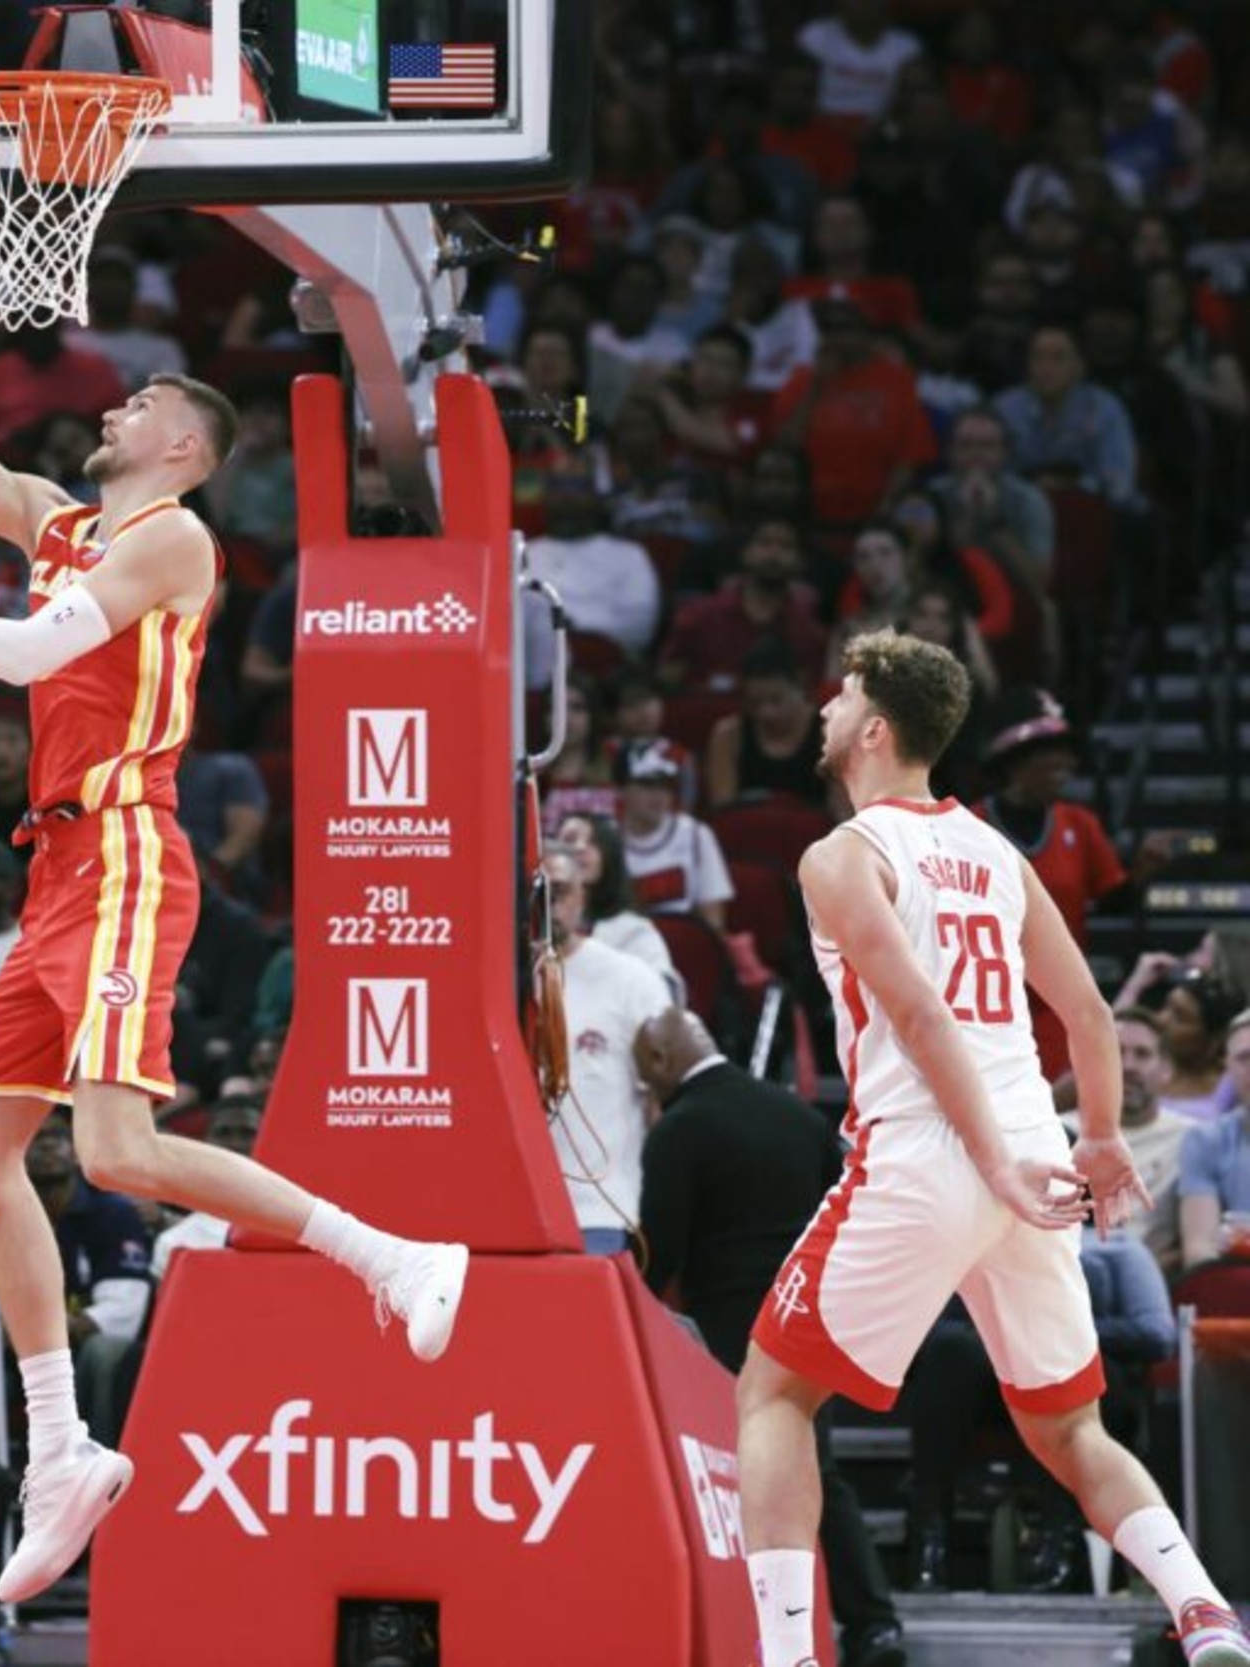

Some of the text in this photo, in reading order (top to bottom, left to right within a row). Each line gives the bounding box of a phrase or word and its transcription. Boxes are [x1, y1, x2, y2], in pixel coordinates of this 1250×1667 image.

[303, 601, 432, 634] reliant
[355, 714, 419, 801] M
[327, 817, 451, 836] MOKARAM
[327, 844, 451, 858] INJURY LAWYERS
[364, 886, 409, 914] 281
[327, 917, 452, 944] 222-2222
[936, 912, 1014, 1023] 28
[356, 983, 420, 1070] M
[327, 1087, 452, 1106] MOKARAM
[327, 1114, 452, 1127] INJURY LAWYERS
[176, 1398, 596, 1544] xfinity
